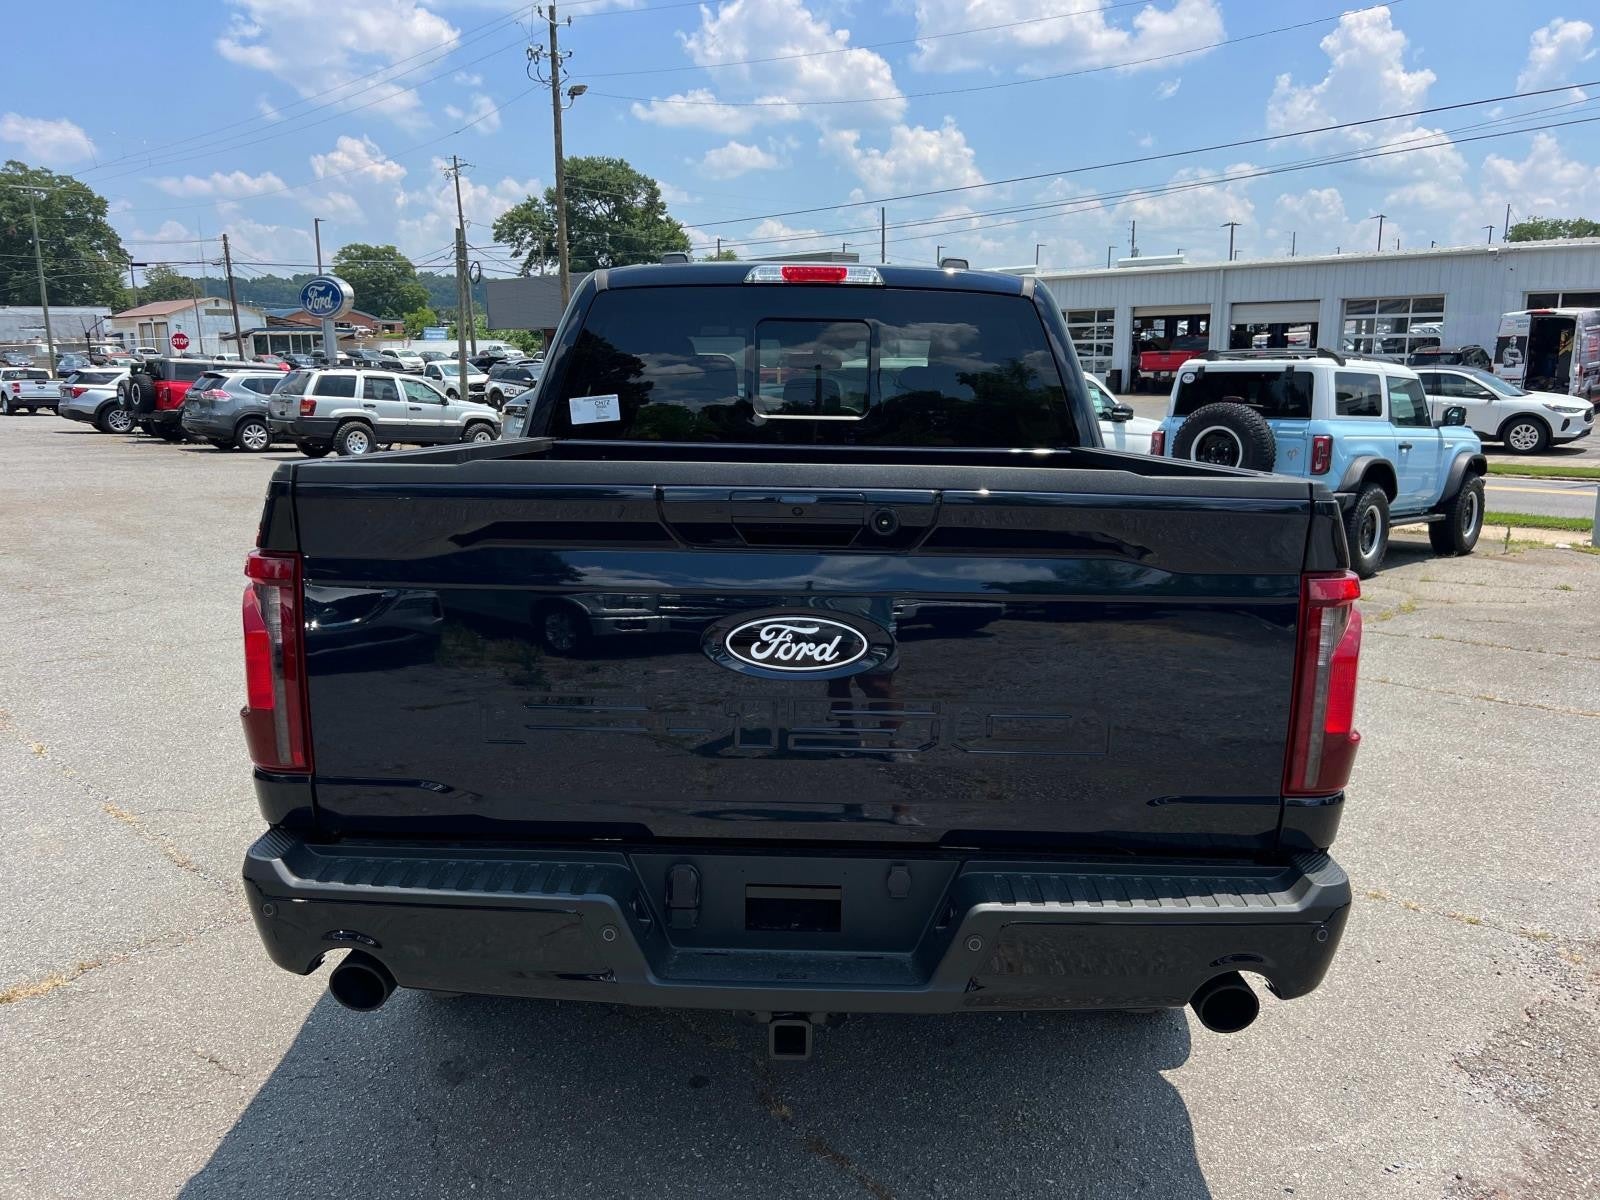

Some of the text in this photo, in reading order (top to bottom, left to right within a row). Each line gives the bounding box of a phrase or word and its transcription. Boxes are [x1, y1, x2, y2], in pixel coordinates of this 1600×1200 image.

[307, 286, 333, 310] Ford
[173, 337, 188, 346] STOP
[750, 624, 842, 661] Ford
